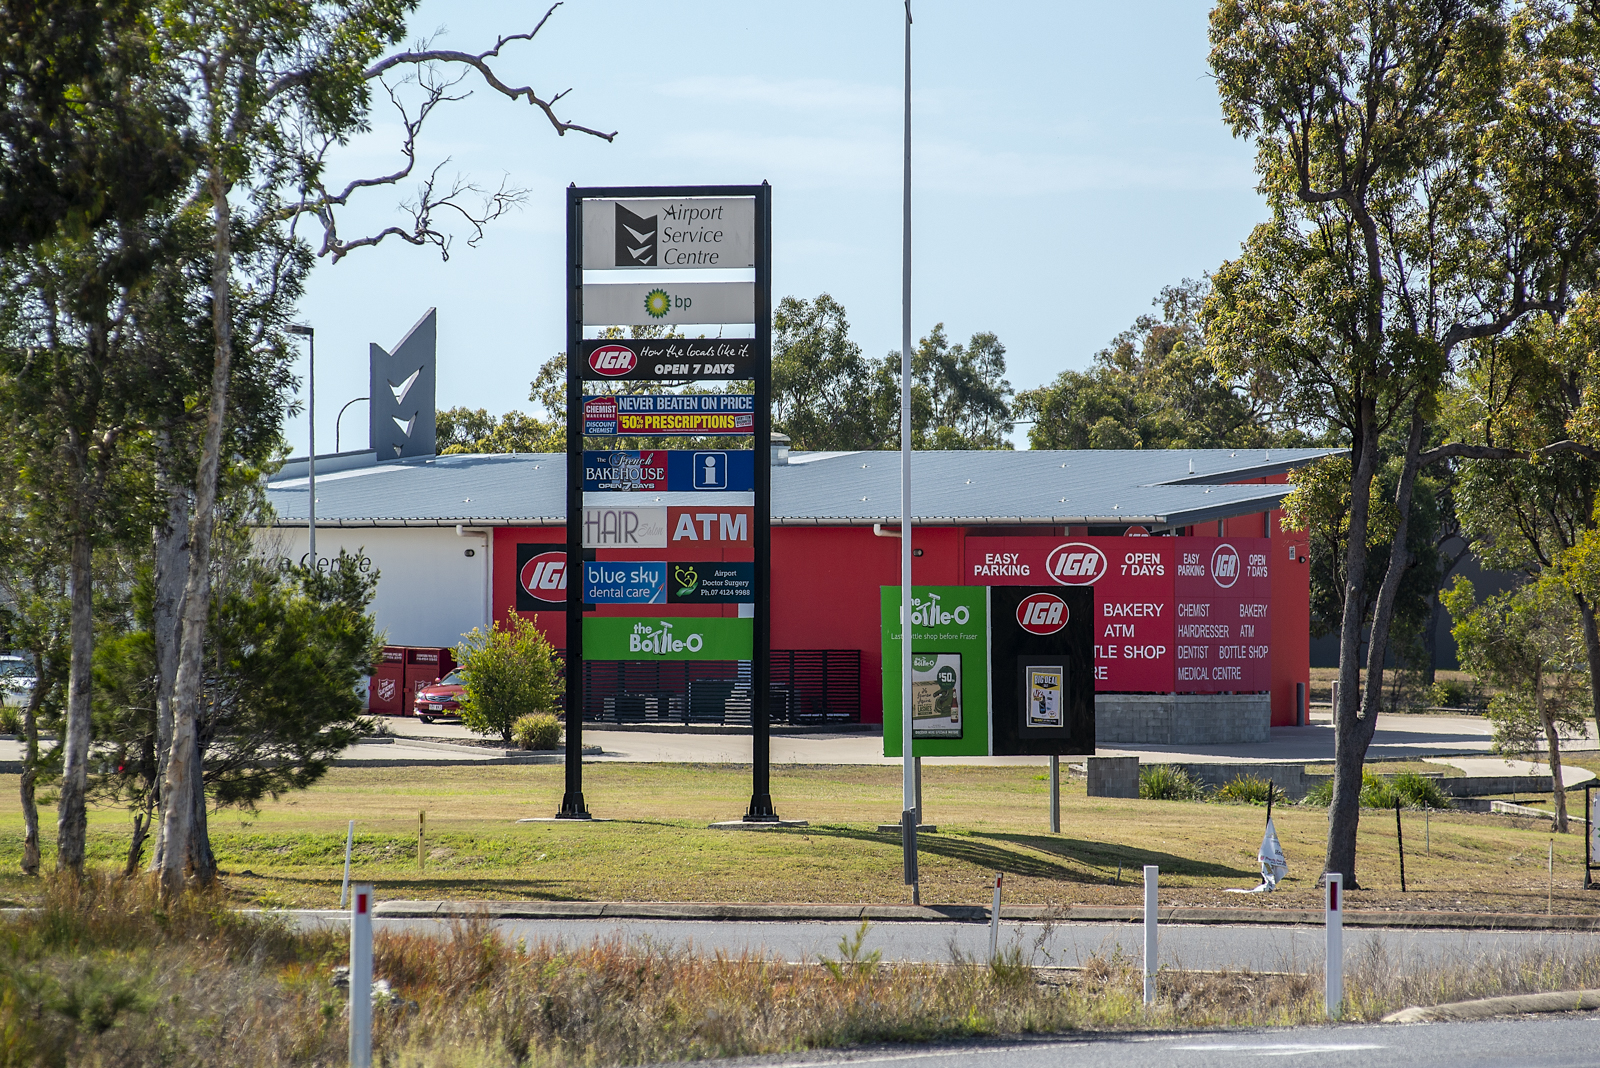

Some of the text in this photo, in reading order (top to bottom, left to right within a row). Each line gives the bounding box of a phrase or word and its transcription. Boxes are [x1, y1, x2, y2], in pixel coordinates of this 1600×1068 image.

[662, 204, 723, 225] Airport
[662, 226, 723, 243] Service
[664, 248, 719, 265] Centre
[674, 295, 692, 311] bp
[640, 346, 664, 357] How
[666, 344, 684, 358] the
[687, 344, 715, 357] locals
[716, 343, 736, 357] like
[595, 352, 633, 370] IGA
[654, 363, 735, 375] OPEN 7 DAYS
[586, 405, 616, 413] CHEMIST
[619, 397, 752, 410] NEVER BEATEN ON PRICE
[644, 415, 735, 429] PRESCRIPTIONS
[608, 452, 654, 468] French
[586, 467, 665, 480] BAKEHOUSE
[622, 481, 632, 490] 7
[584, 510, 664, 544] HAIR Salon
[672, 513, 747, 541] ATM
[985, 553, 1019, 564] EASY
[1054, 553, 1099, 576] IGA
[1124, 552, 1161, 564] OPEN
[1183, 553, 1200, 564] EASY
[1249, 554, 1266, 565] OPEN
[974, 565, 1030, 576] PARKING
[1120, 564, 1165, 576] 7 DAYS
[1178, 565, 1205, 577] PARKING
[1215, 555, 1236, 577] IGA
[1247, 566, 1268, 577] 7 DAYS
[588, 566, 658, 588] blue sky
[714, 570, 737, 578] Airport
[724, 580, 749, 588] Surgery
[589, 586, 650, 598] dental care
[900, 593, 970, 627] ottle-O
[1022, 602, 1064, 625] IGA
[1103, 603, 1164, 617] BAKERY
[1178, 603, 1268, 618] CHEMIST BAKERY
[634, 622, 653, 634] the
[1104, 624, 1135, 638] ATM
[1178, 624, 1255, 638] HAIRDRESSER ATM
[924, 633, 938, 641] shop
[939, 632, 959, 640] before
[959, 632, 978, 640] Fraser
[1123, 645, 1166, 659] SHOP
[1178, 645, 1269, 659] DENTIST BOTTLE SHOP
[1178, 667, 1241, 680] MEDICAL CENTRE
